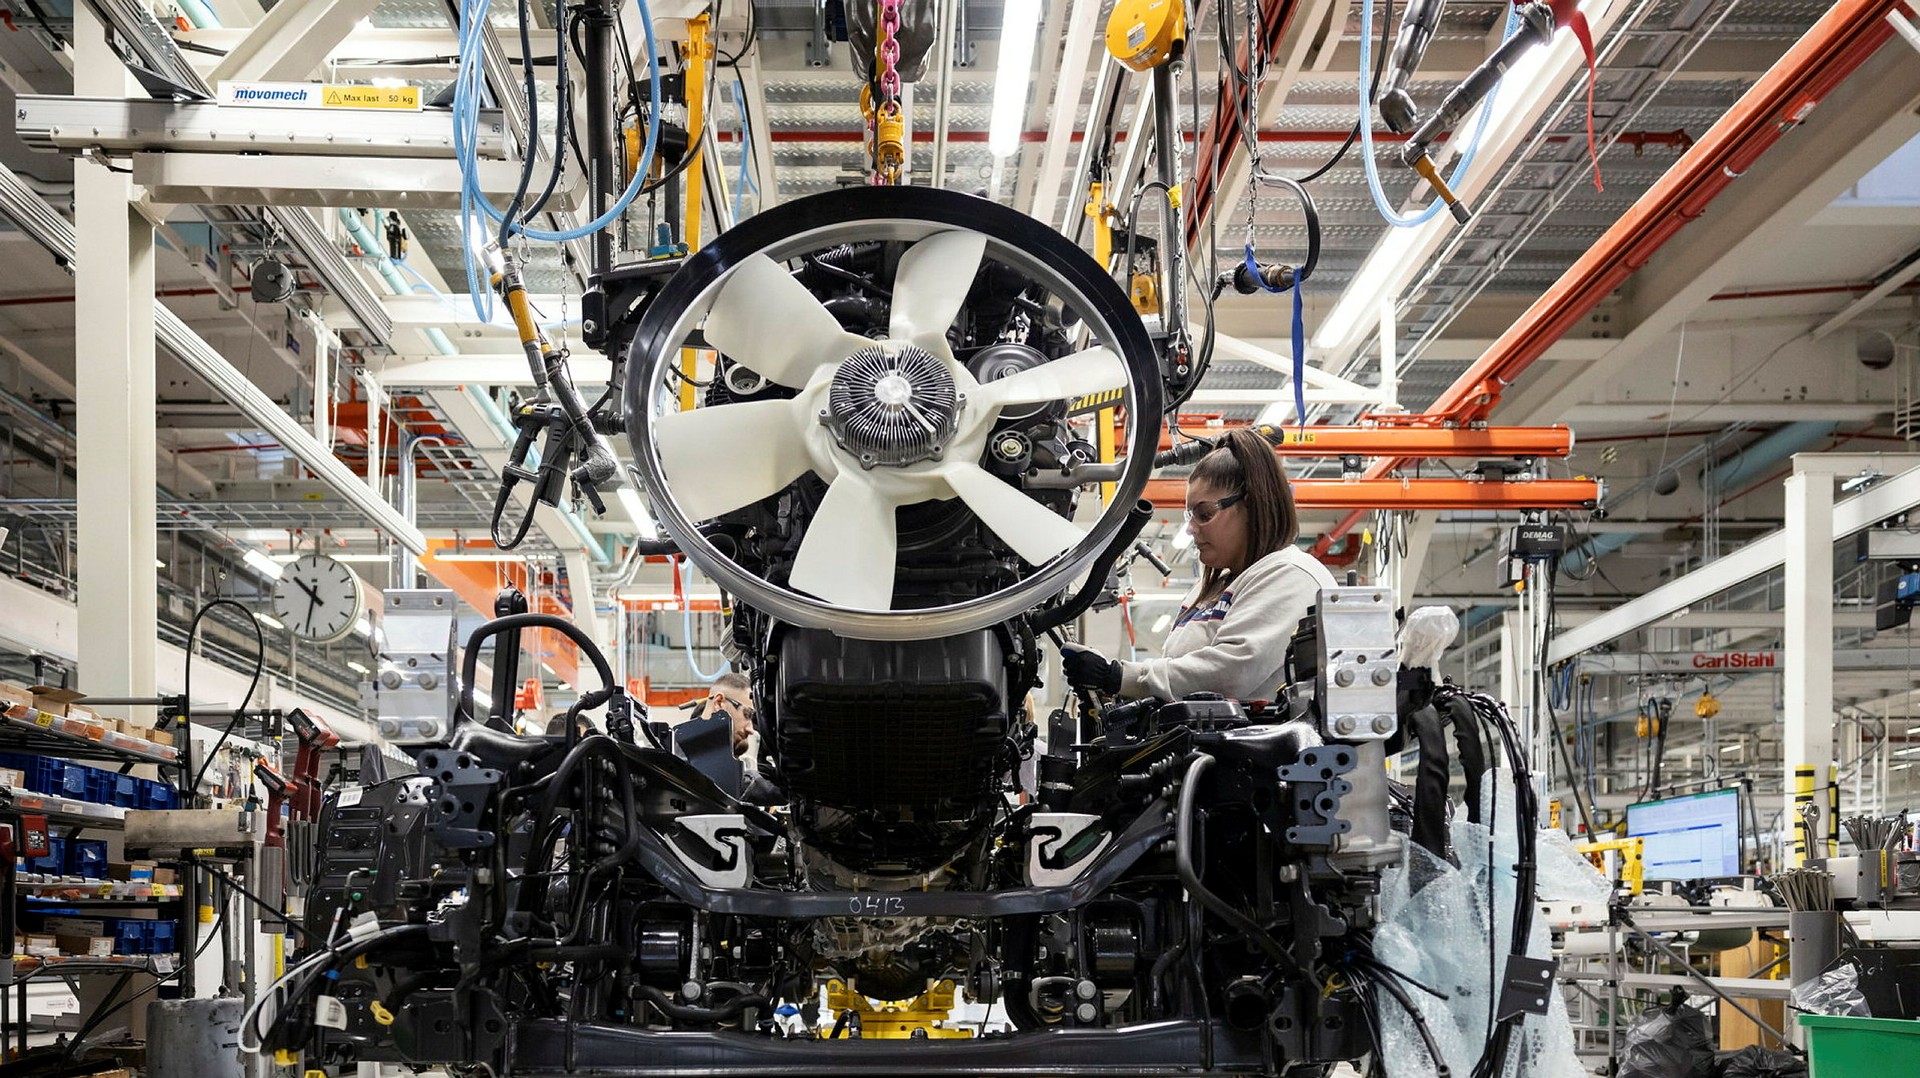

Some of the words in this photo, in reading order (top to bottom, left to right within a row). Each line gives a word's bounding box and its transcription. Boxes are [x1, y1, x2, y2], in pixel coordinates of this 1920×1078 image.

[235, 89, 307, 101] movomech
[344, 94, 361, 102] Max
[364, 94, 379, 102] last
[402, 96, 413, 104] kg
[1522, 531, 1554, 539] DEMAG
[849, 896, 905, 915] 0413
